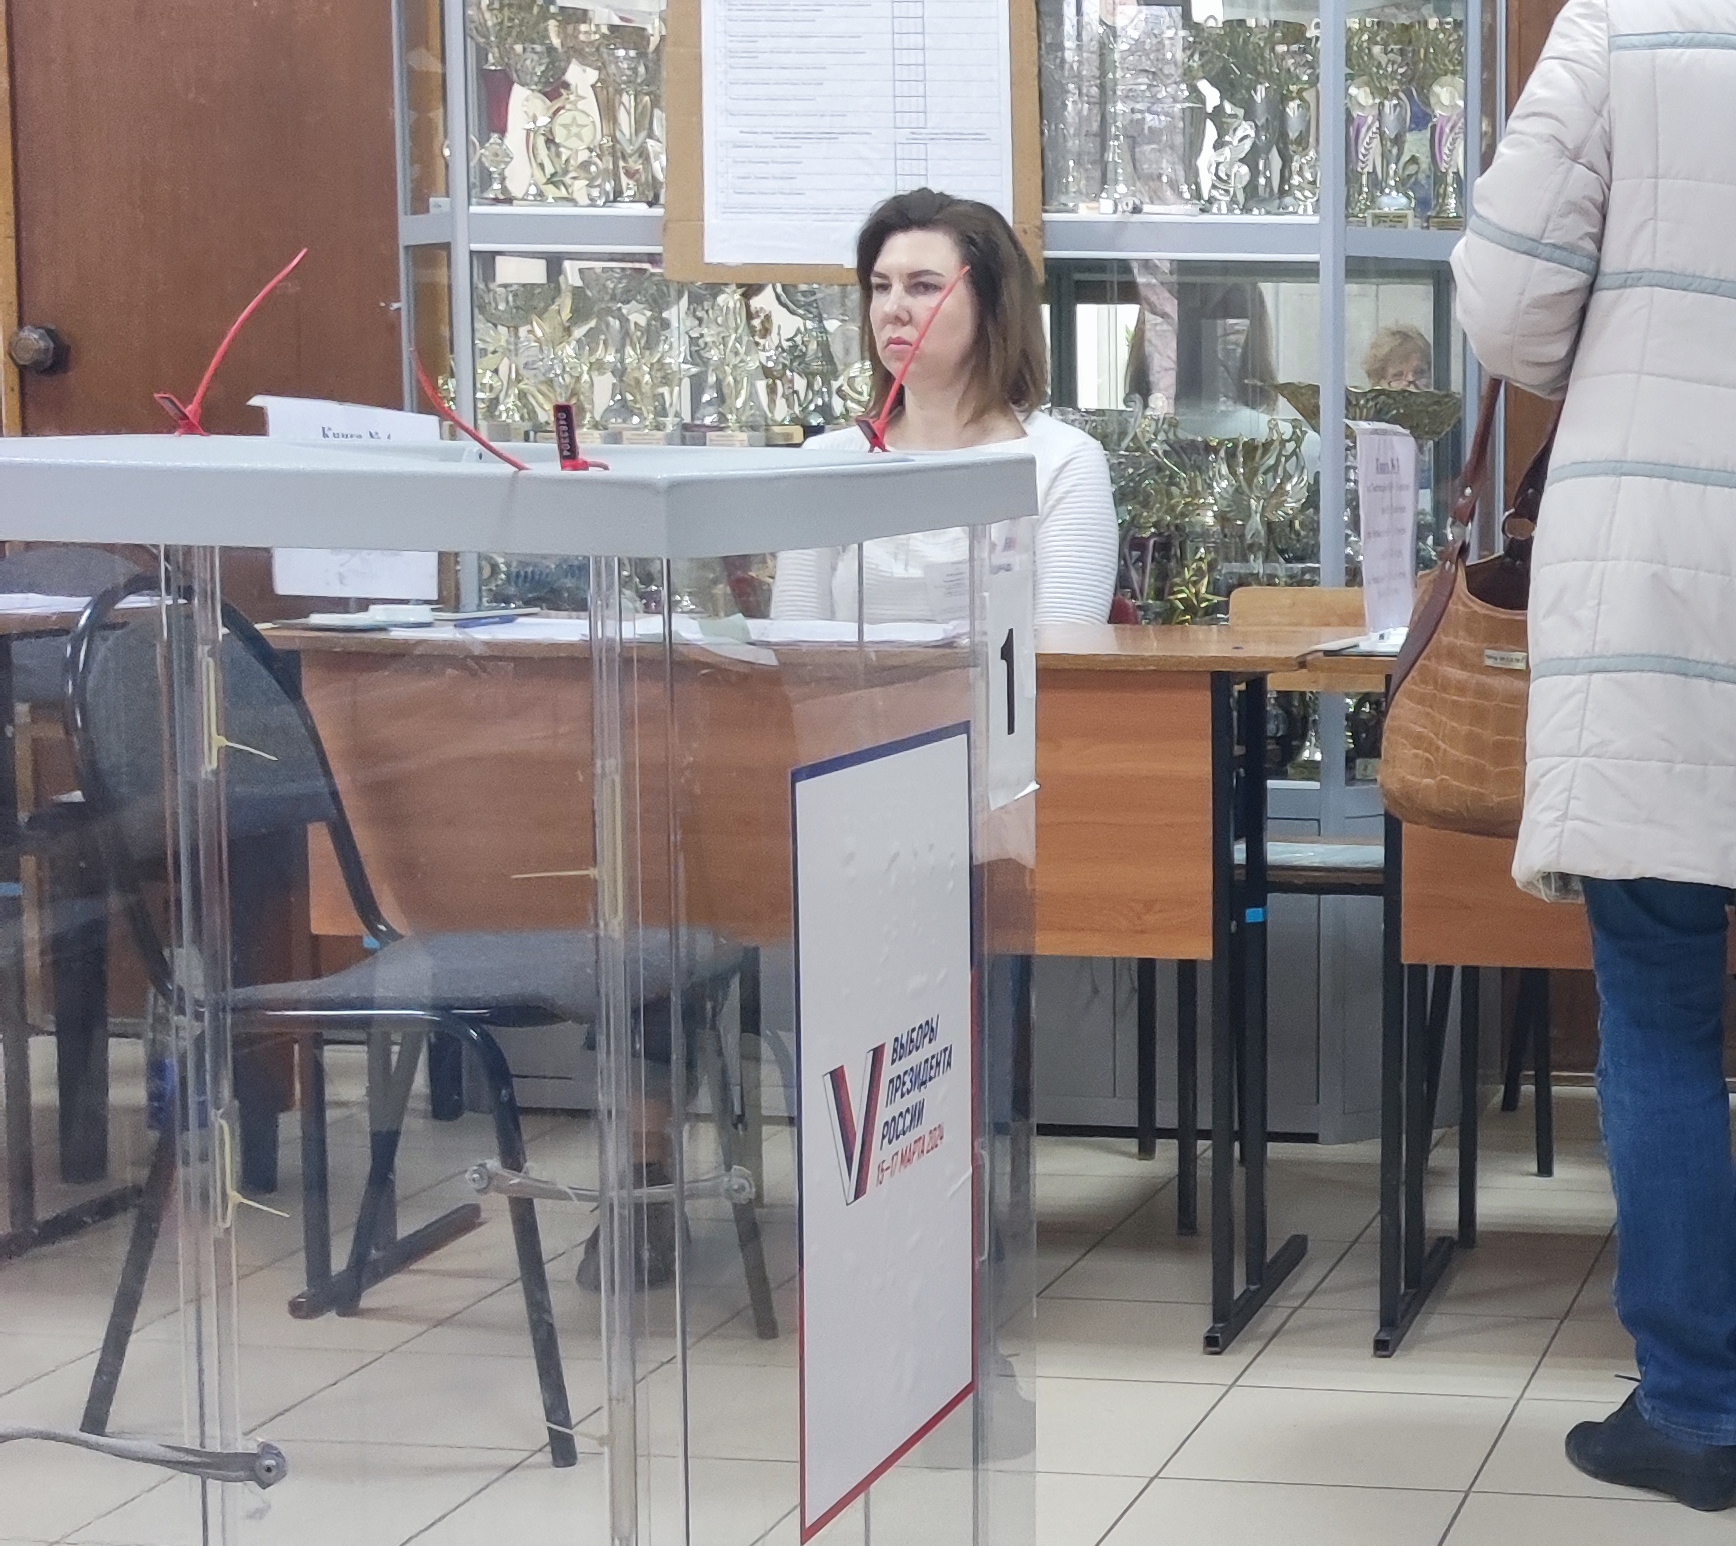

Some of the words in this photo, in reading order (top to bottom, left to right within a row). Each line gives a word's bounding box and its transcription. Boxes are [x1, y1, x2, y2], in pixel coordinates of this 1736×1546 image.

[1000, 628, 1015, 735] 1
[890, 1014, 940, 1066] ВЫБОРЫ
[886, 1044, 953, 1108] ПРЕЗИДЕНТА
[880, 1098, 925, 1151] РОССИИ
[899, 1134, 926, 1173] МАРТА
